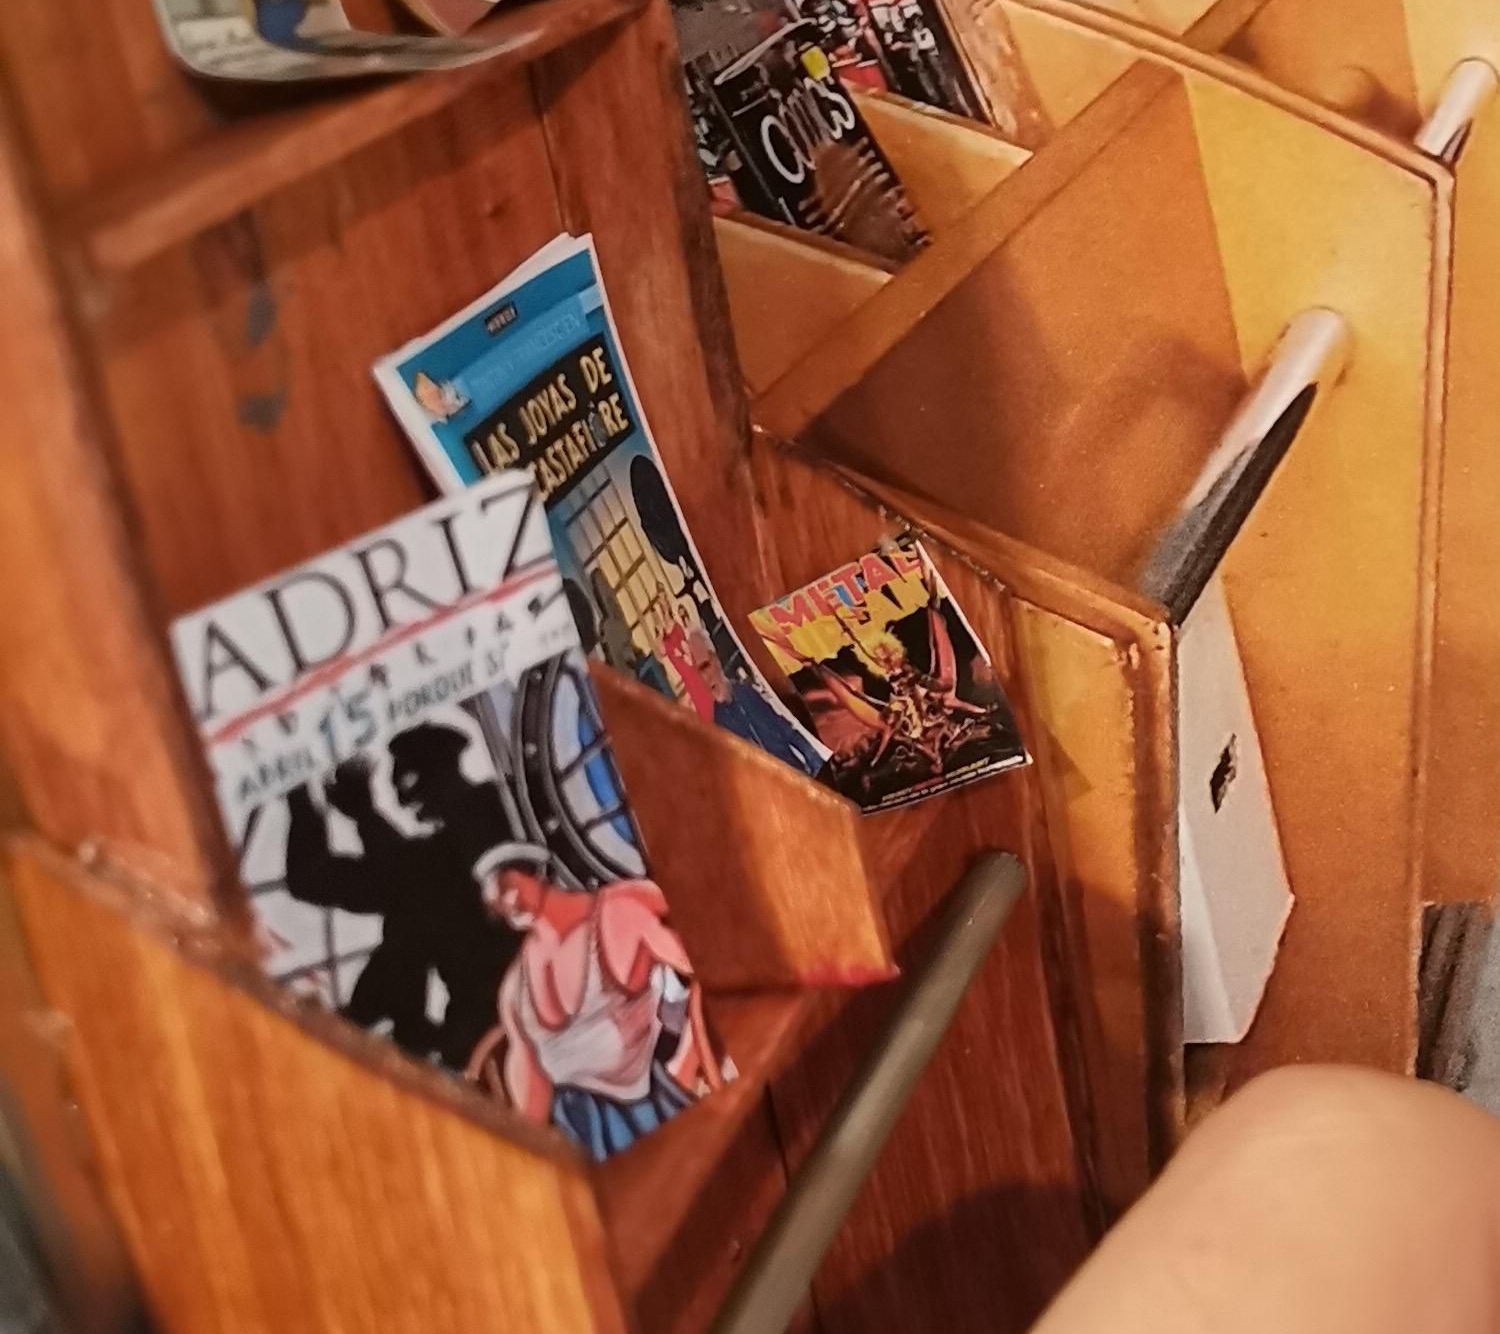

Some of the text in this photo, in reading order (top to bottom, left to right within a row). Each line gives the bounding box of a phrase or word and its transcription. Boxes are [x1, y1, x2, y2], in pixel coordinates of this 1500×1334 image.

[471, 423, 521, 476] LAS
[519, 373, 577, 445] JOYAS
[579, 346, 612, 393] DE
[767, 551, 923, 635] METAL
